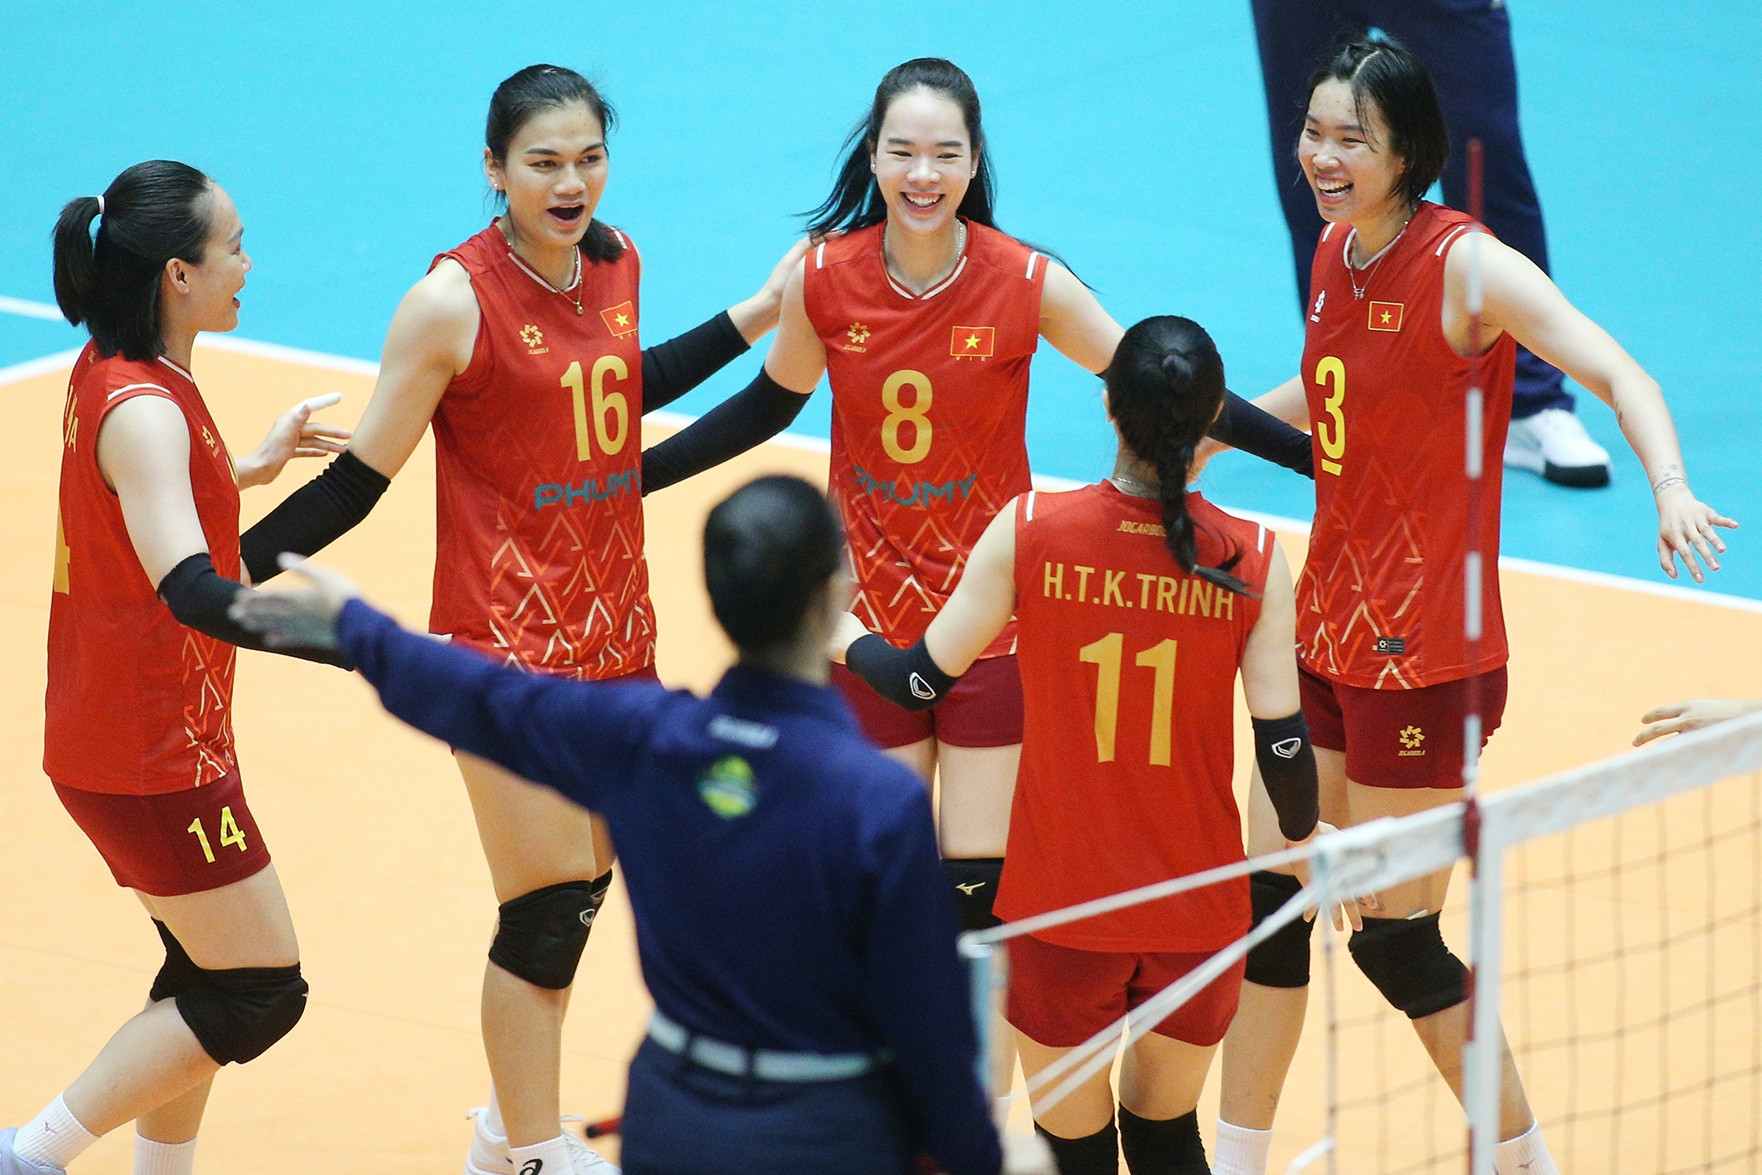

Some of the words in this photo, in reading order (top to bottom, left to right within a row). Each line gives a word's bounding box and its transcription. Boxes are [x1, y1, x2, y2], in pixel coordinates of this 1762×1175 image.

[560, 355, 628, 462] 16
[881, 369, 933, 464] 8
[1316, 355, 1346, 460] 3
[1117, 520, 1167, 537] JOGARBOL
[1044, 561, 1234, 621] H.T.K.TRINH
[1079, 632, 1178, 767] 11
[187, 805, 248, 864] 14
